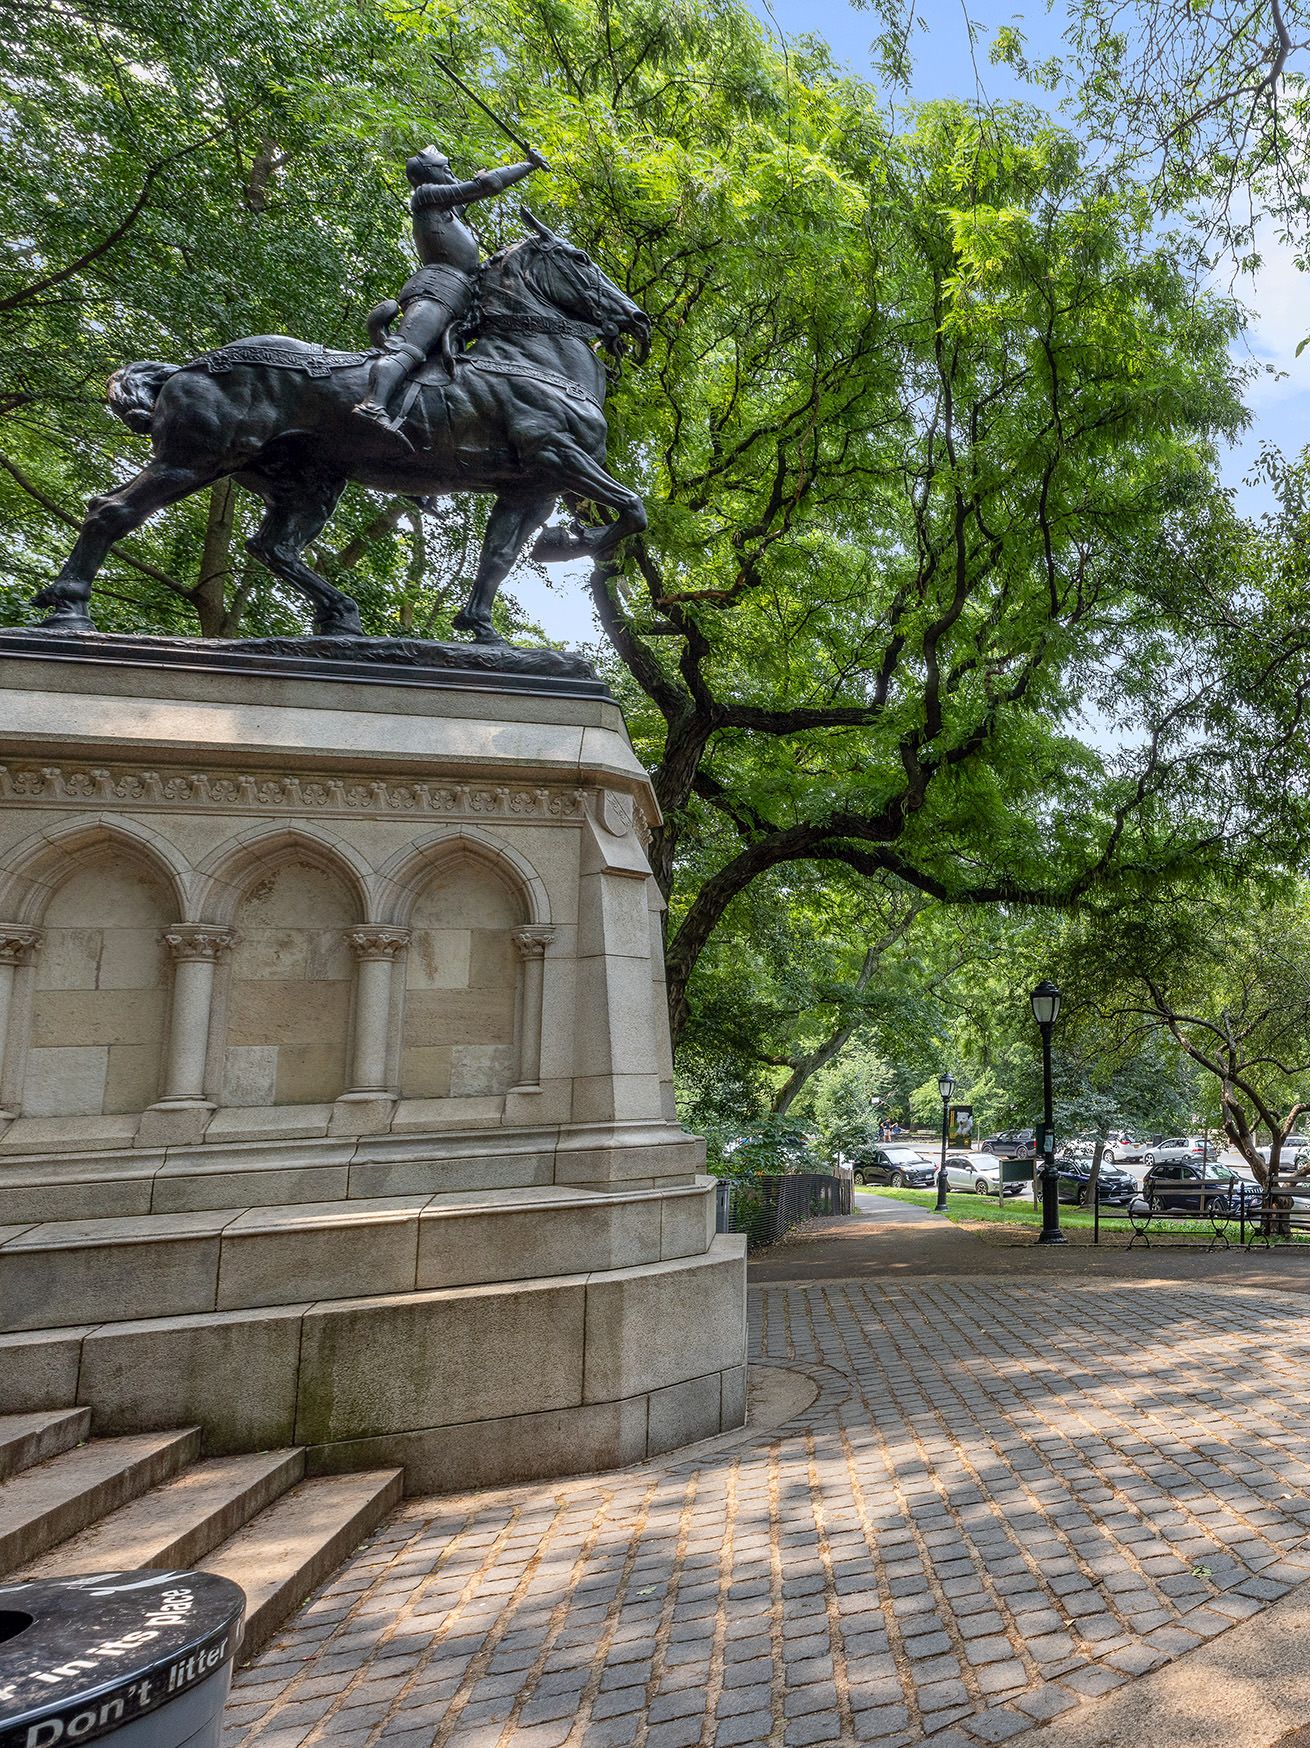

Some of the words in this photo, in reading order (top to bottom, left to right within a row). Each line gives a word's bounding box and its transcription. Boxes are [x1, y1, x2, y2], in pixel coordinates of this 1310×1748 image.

[28, 1660, 99, 1683] in
[85, 1630, 159, 1656] its
[143, 1588, 195, 1626] place
[168, 1637, 228, 1693] litter
